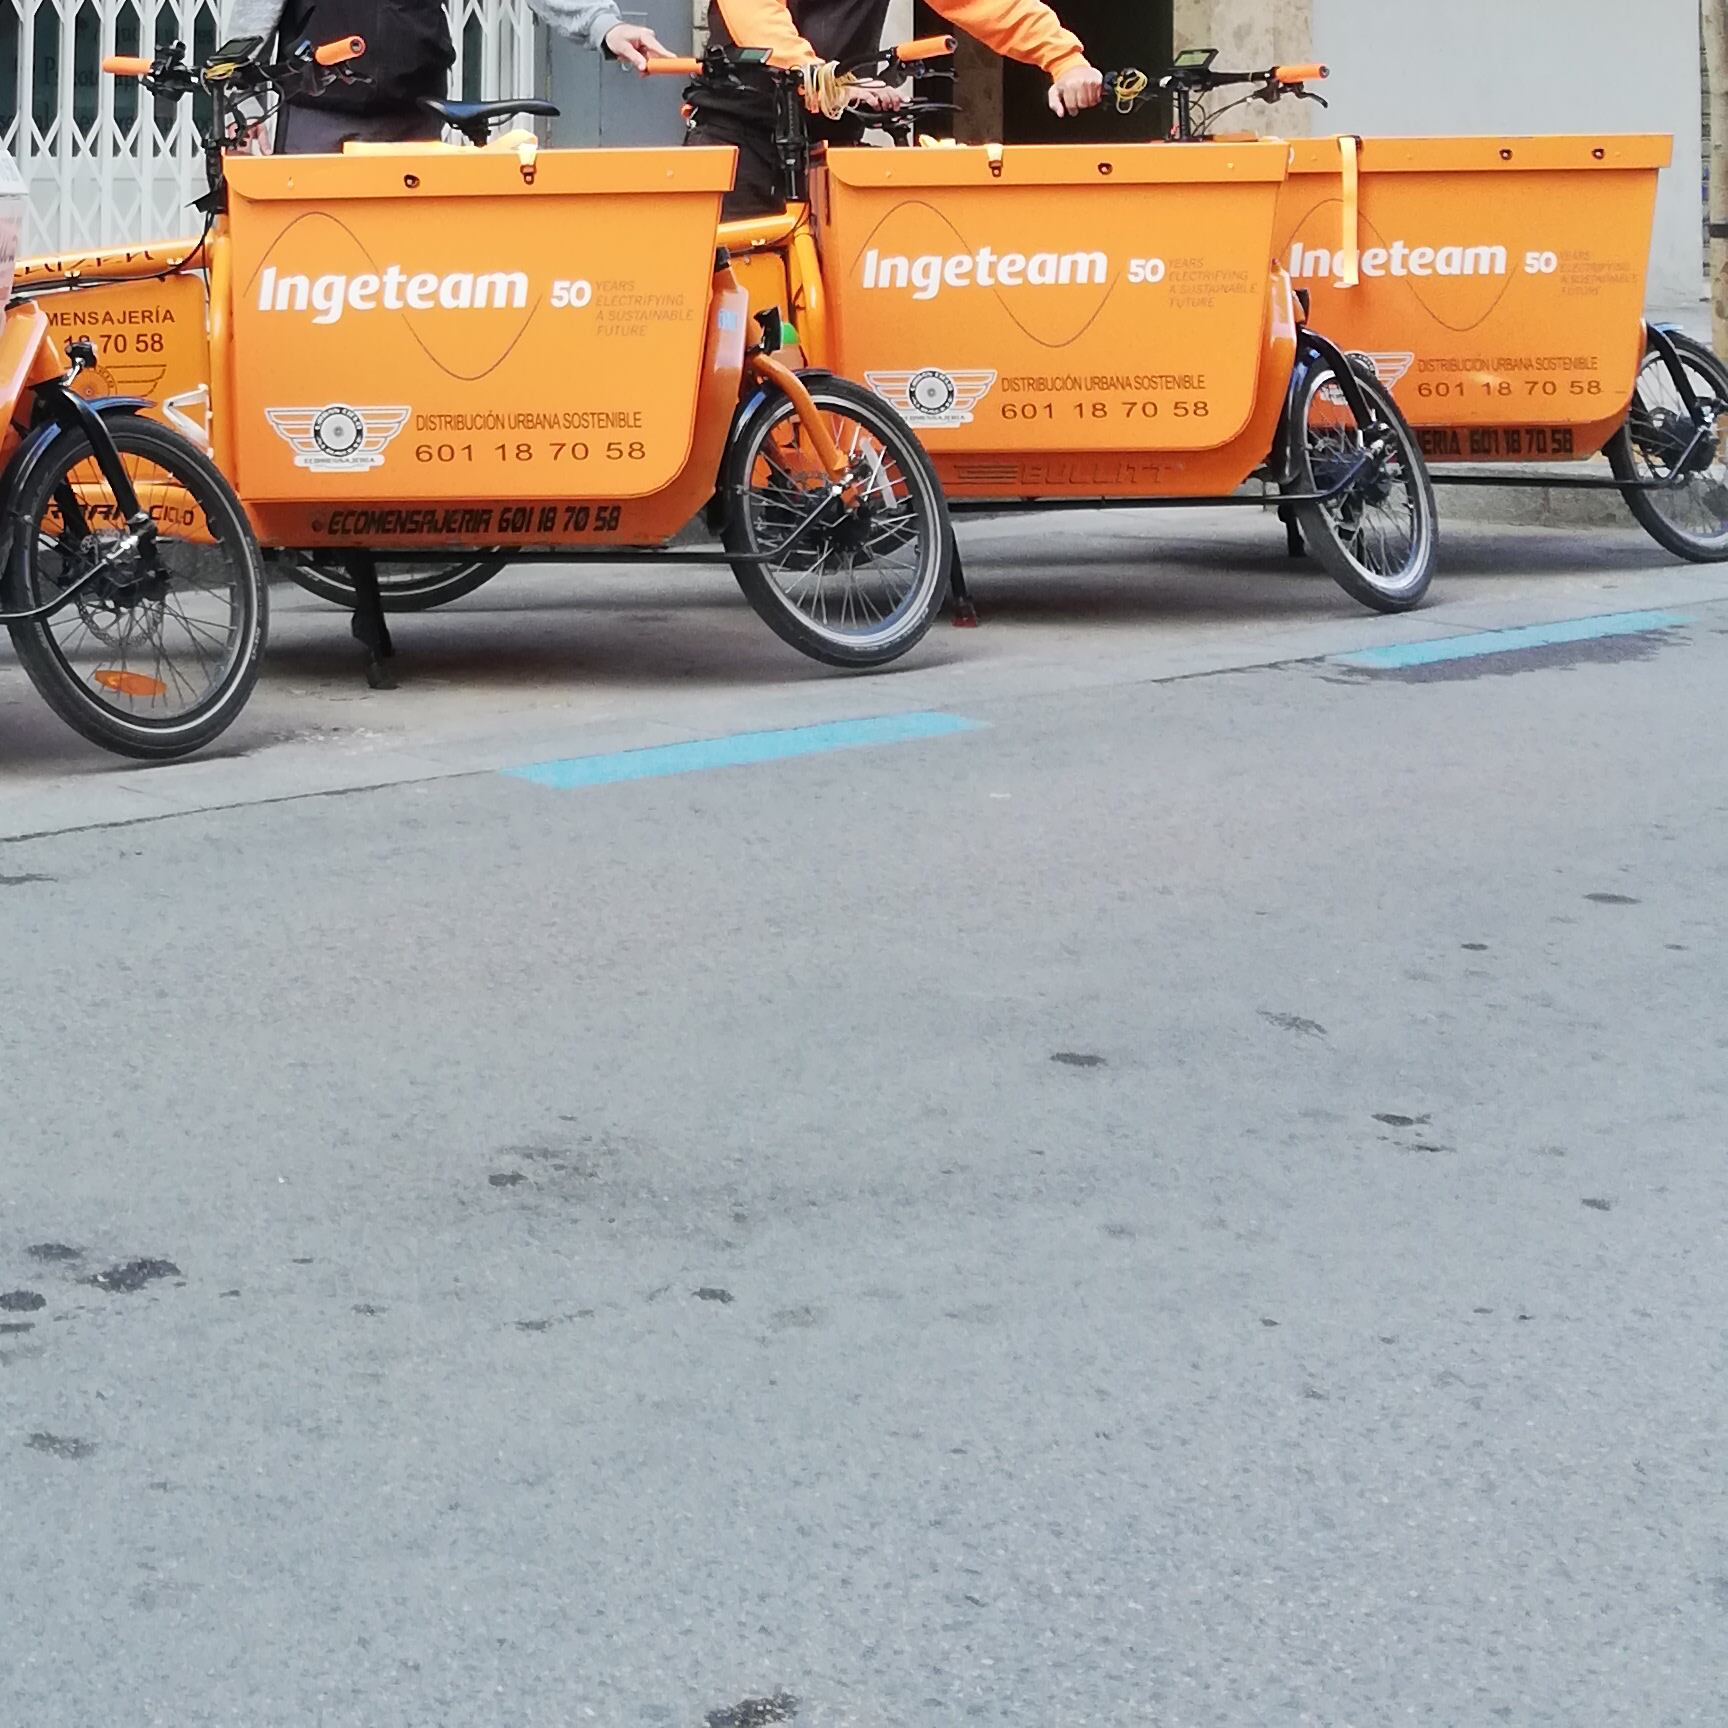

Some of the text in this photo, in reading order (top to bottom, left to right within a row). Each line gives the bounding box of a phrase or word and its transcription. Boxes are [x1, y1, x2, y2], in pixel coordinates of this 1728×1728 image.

[862, 246, 1165, 300] Ingeteam 50
[1524, 251, 1558, 274] 50
[257, 264, 592, 325] Ingeteam 50
[46, 305, 176, 327] MENSAJERÍA
[100, 335, 127, 354] 70
[136, 333, 164, 353] 58
[1001, 374, 1205, 392] DISTRIBUCIÓN URBANA SOSTENIBLE
[1418, 379, 1603, 398] 601 18 70 58
[416, 410, 642, 431] DISTRIBUCIÓN URBANA SOSTENIBLE
[1001, 400, 1209, 420] 601 18 70 58
[1526, 428, 1548, 453] 70
[415, 441, 646, 462] 601 18 70 58
[562, 506, 591, 532] 70
[593, 506, 621, 531] 58
